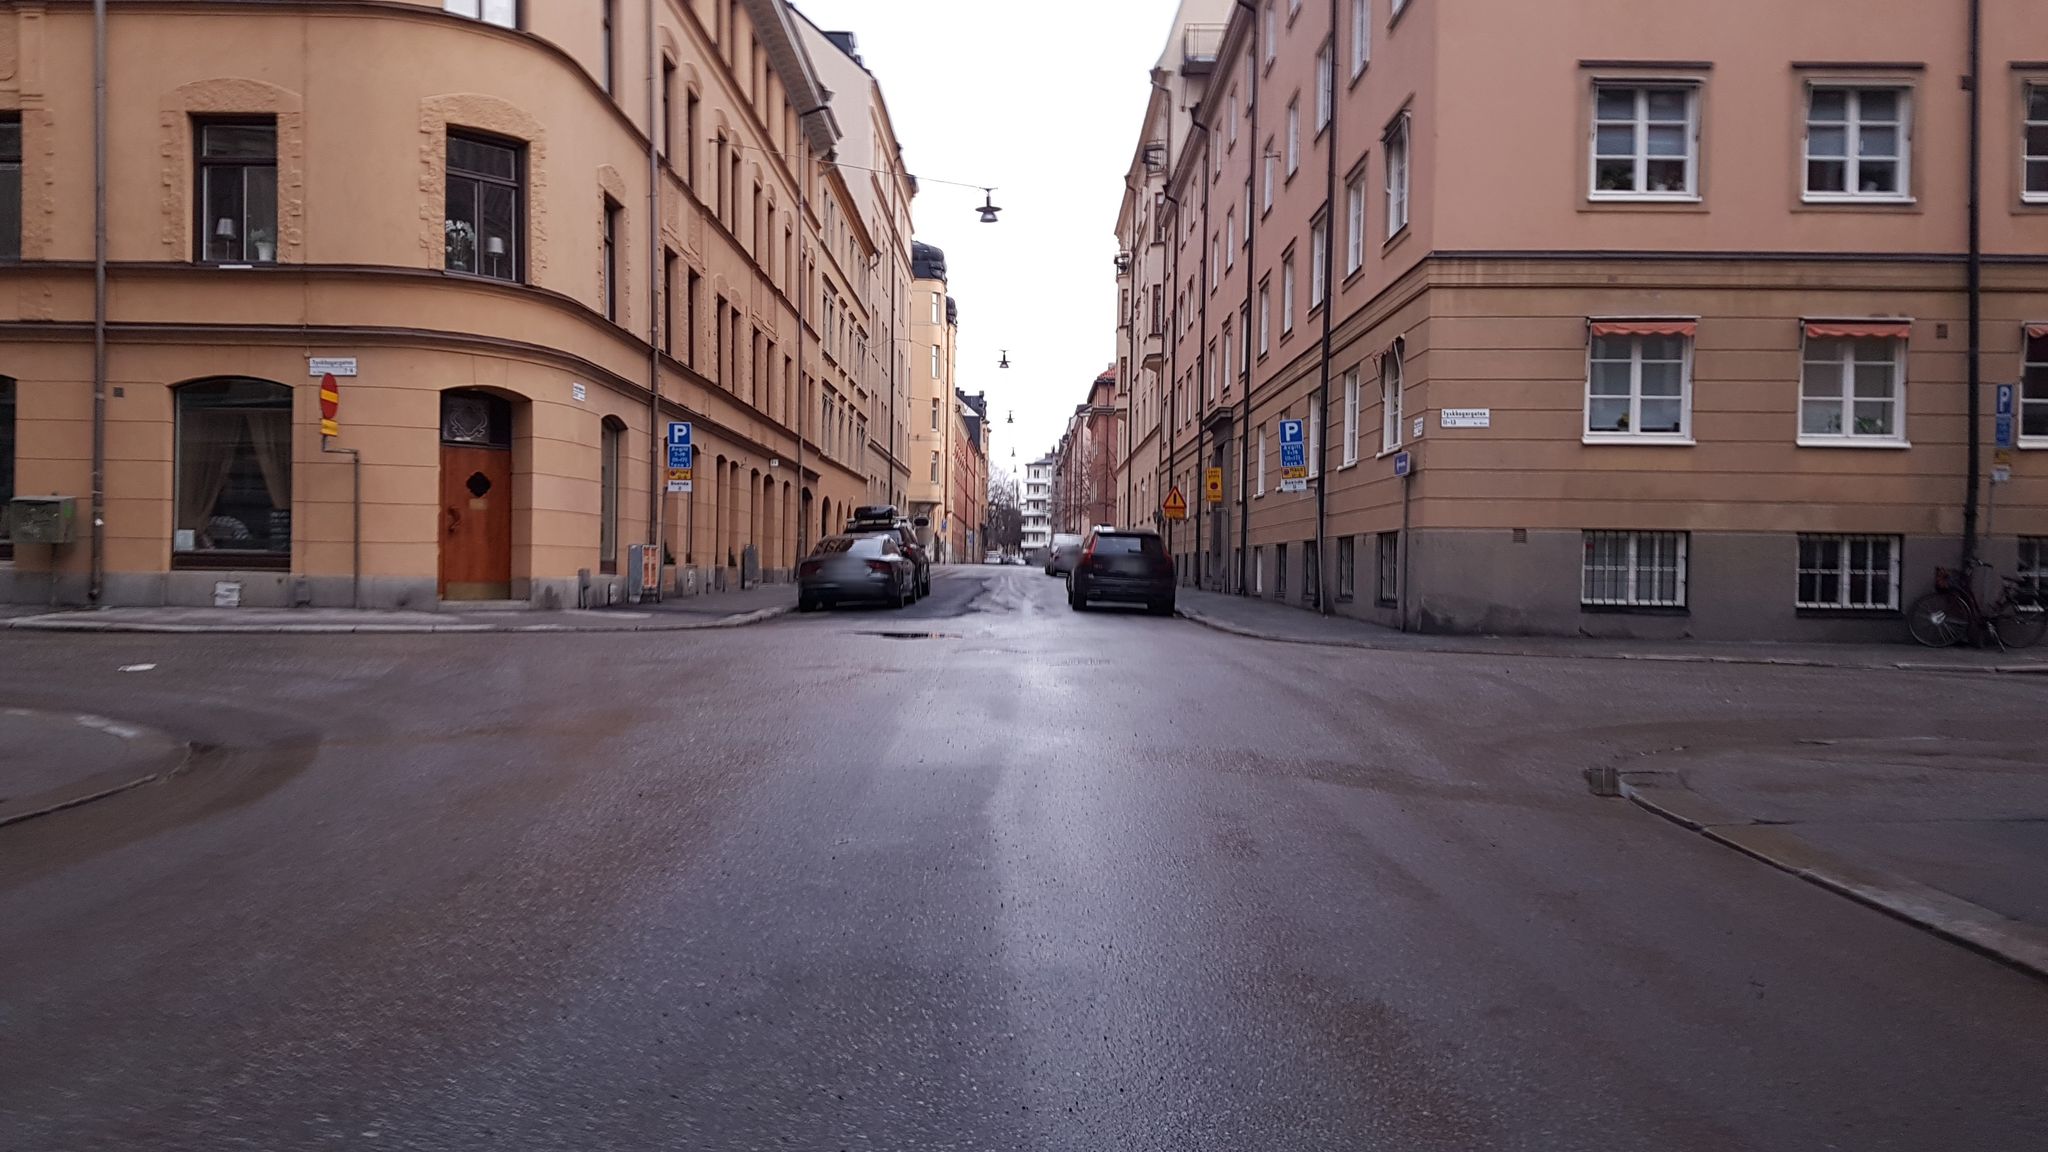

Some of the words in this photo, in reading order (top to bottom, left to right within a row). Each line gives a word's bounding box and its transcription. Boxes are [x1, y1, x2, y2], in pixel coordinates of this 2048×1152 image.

[1999, 386, 2010, 412] P
[1443, 410, 1486, 418] Tyskbagargatan
[673, 425, 687, 443] P
[1285, 423, 1298, 441] P
